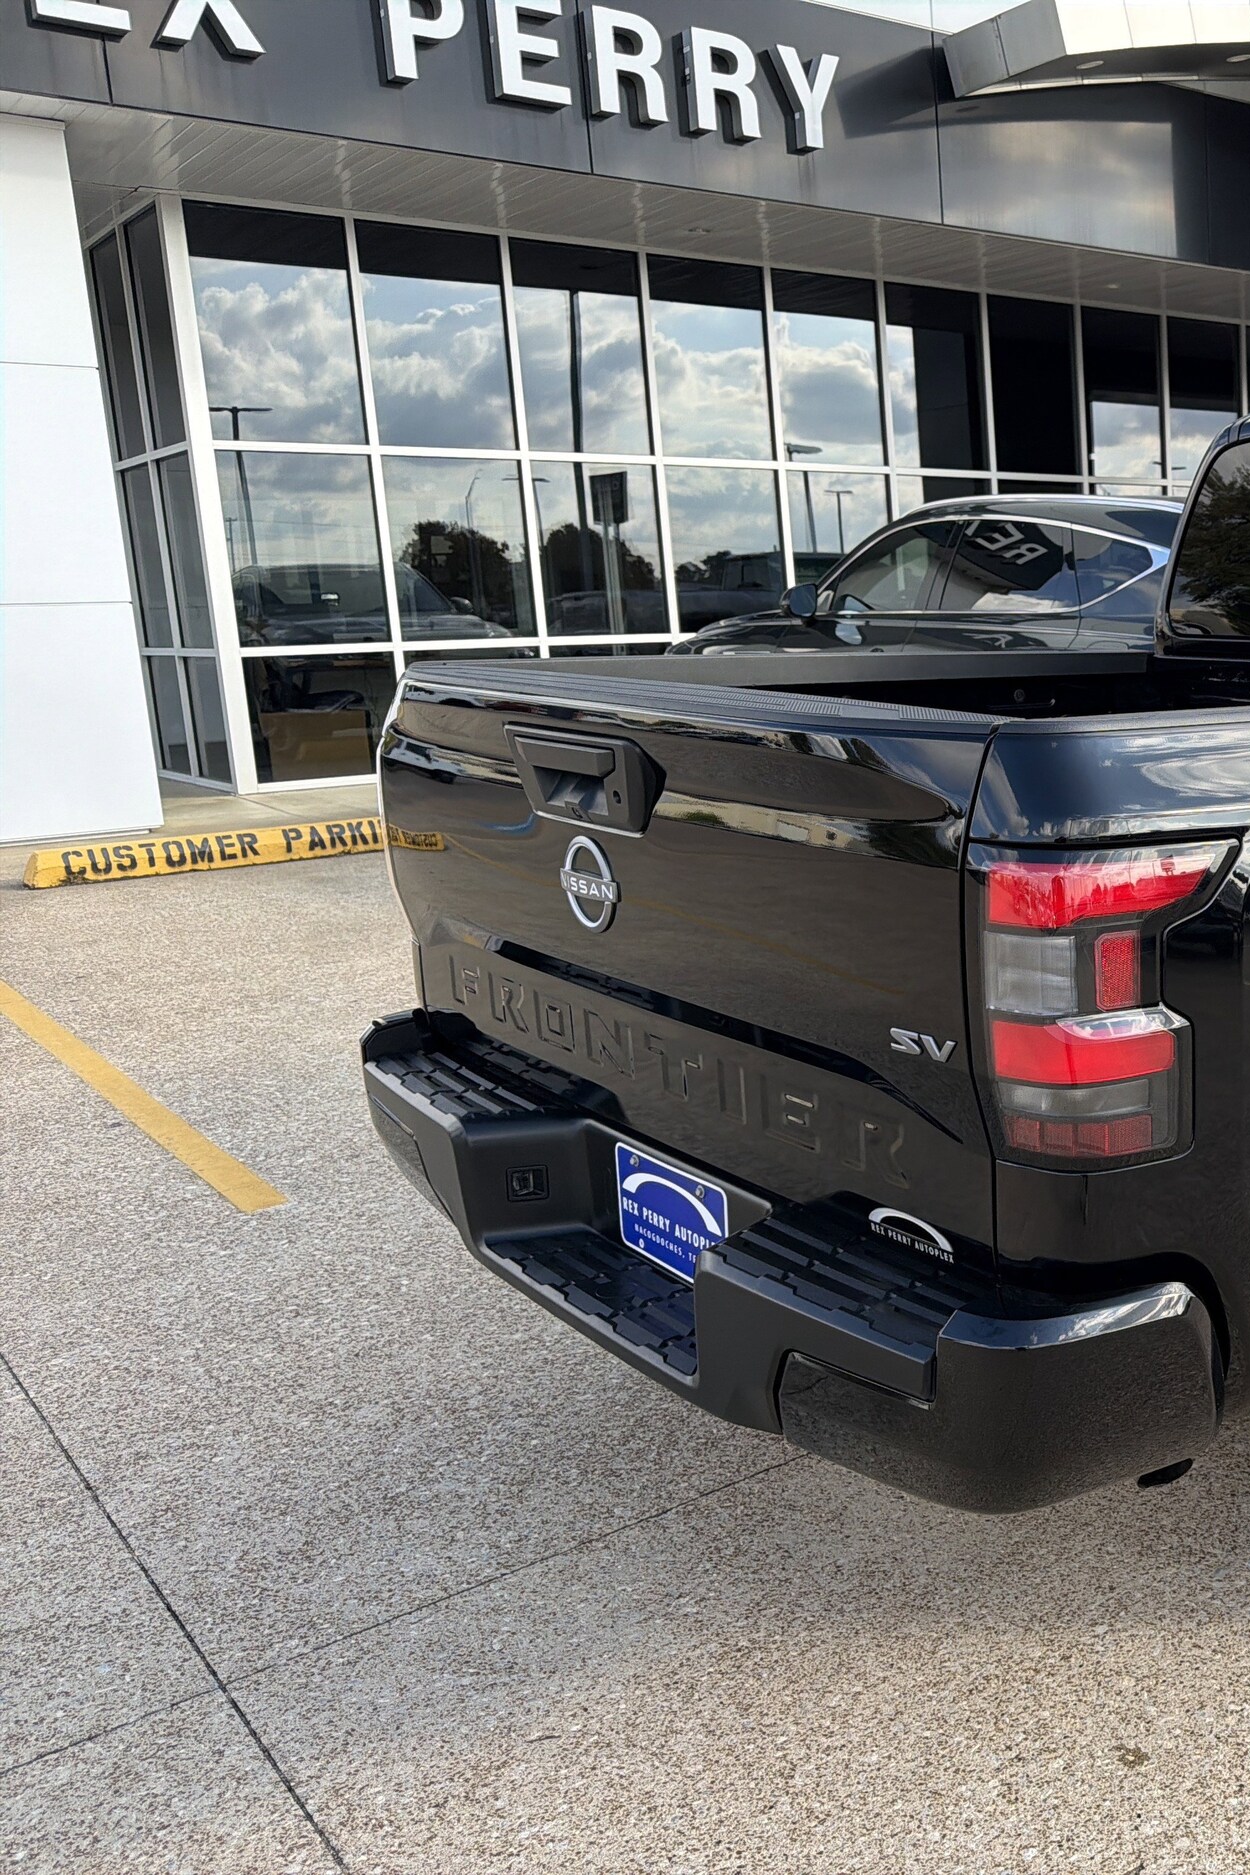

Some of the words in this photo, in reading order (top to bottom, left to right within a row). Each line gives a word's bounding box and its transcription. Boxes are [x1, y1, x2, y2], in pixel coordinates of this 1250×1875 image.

[381, 0, 840, 154] PERRY
[60, 832, 260, 878] CUSTOMER
[281, 818, 383, 854] PARKI
[560, 871, 614, 900] NISSAN
[448, 952, 911, 1190] FRONTIER
[890, 1027, 957, 1063] SV
[622, 1196, 639, 1216] REX
[642, 1207, 671, 1232] PERRY
[674, 1223, 715, 1250] AUTOPL
[870, 1222, 886, 1236] REX
[887, 1229, 911, 1246] PERRY
[914, 1240, 955, 1264] AUTOPLEX
